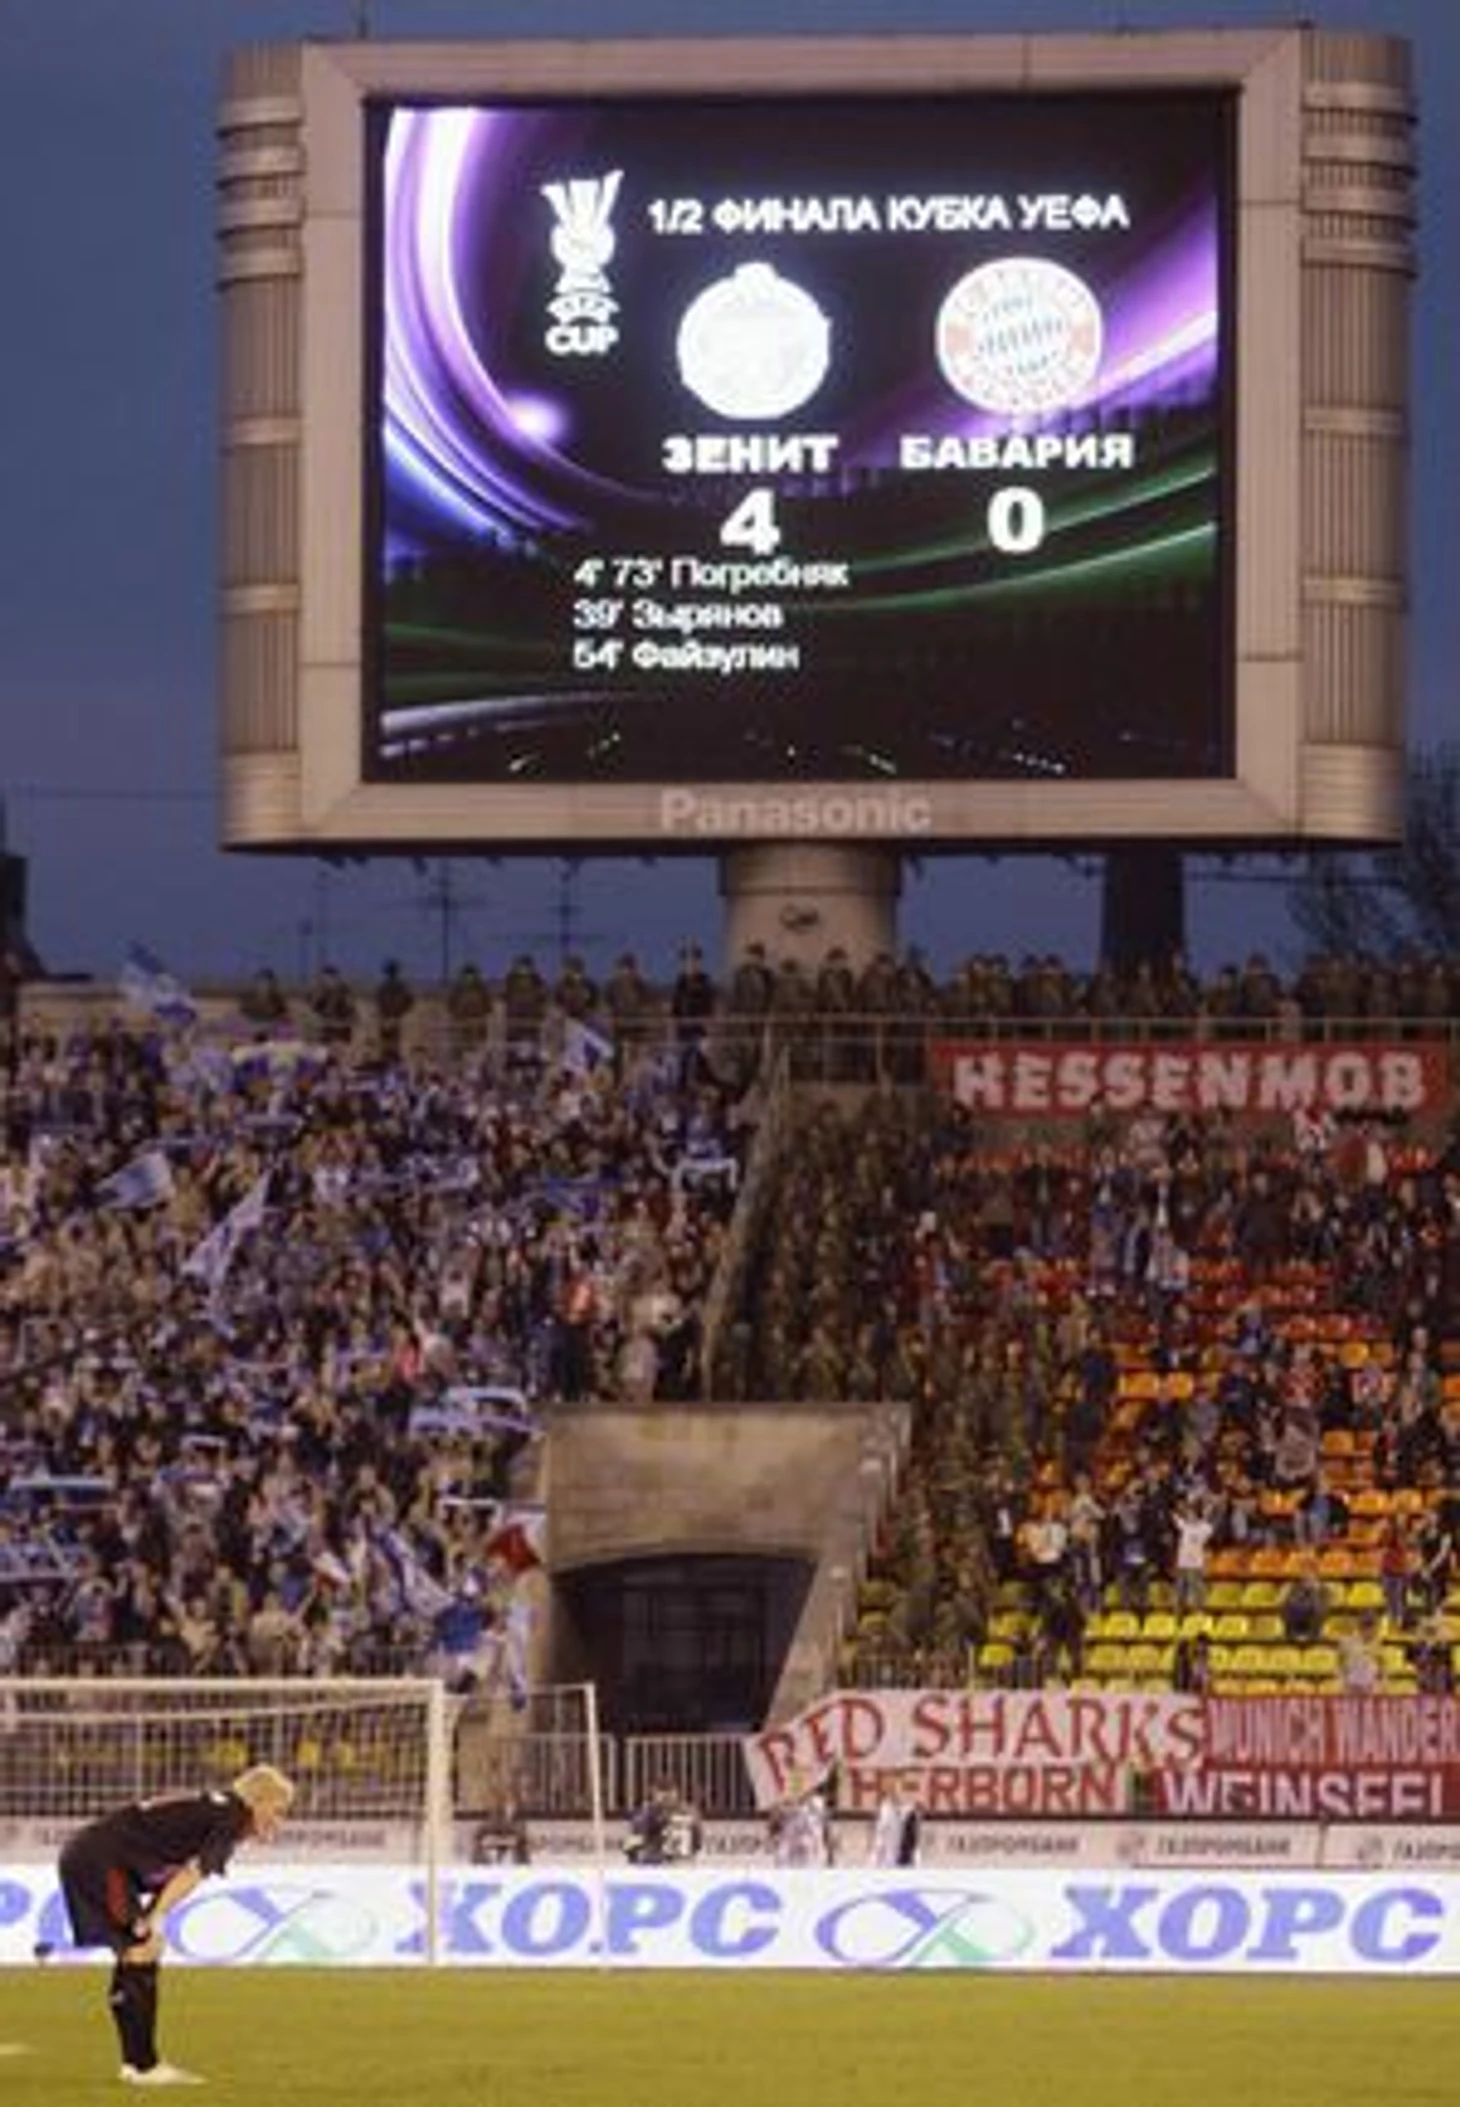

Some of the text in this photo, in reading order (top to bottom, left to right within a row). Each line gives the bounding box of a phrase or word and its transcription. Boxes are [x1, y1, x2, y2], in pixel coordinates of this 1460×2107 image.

[648, 195, 1131, 234] 1/2 ФИНАЛА КУБКА УЕФА
[544, 325, 620, 356] CUP
[661, 435, 838, 474] ЗЕНИТ
[900, 434, 1135, 470] БАВАРИЯ
[719, 488, 782, 556] 4
[987, 486, 1046, 554] 0
[660, 787, 931, 833] Panasonic
[953, 1048, 1425, 1108] HESSENMOB
[757, 1692, 1206, 1796] RED SHARKS
[849, 1763, 1128, 1812] HERBORN
[1050, 1883, 1444, 1962] ХОРС
